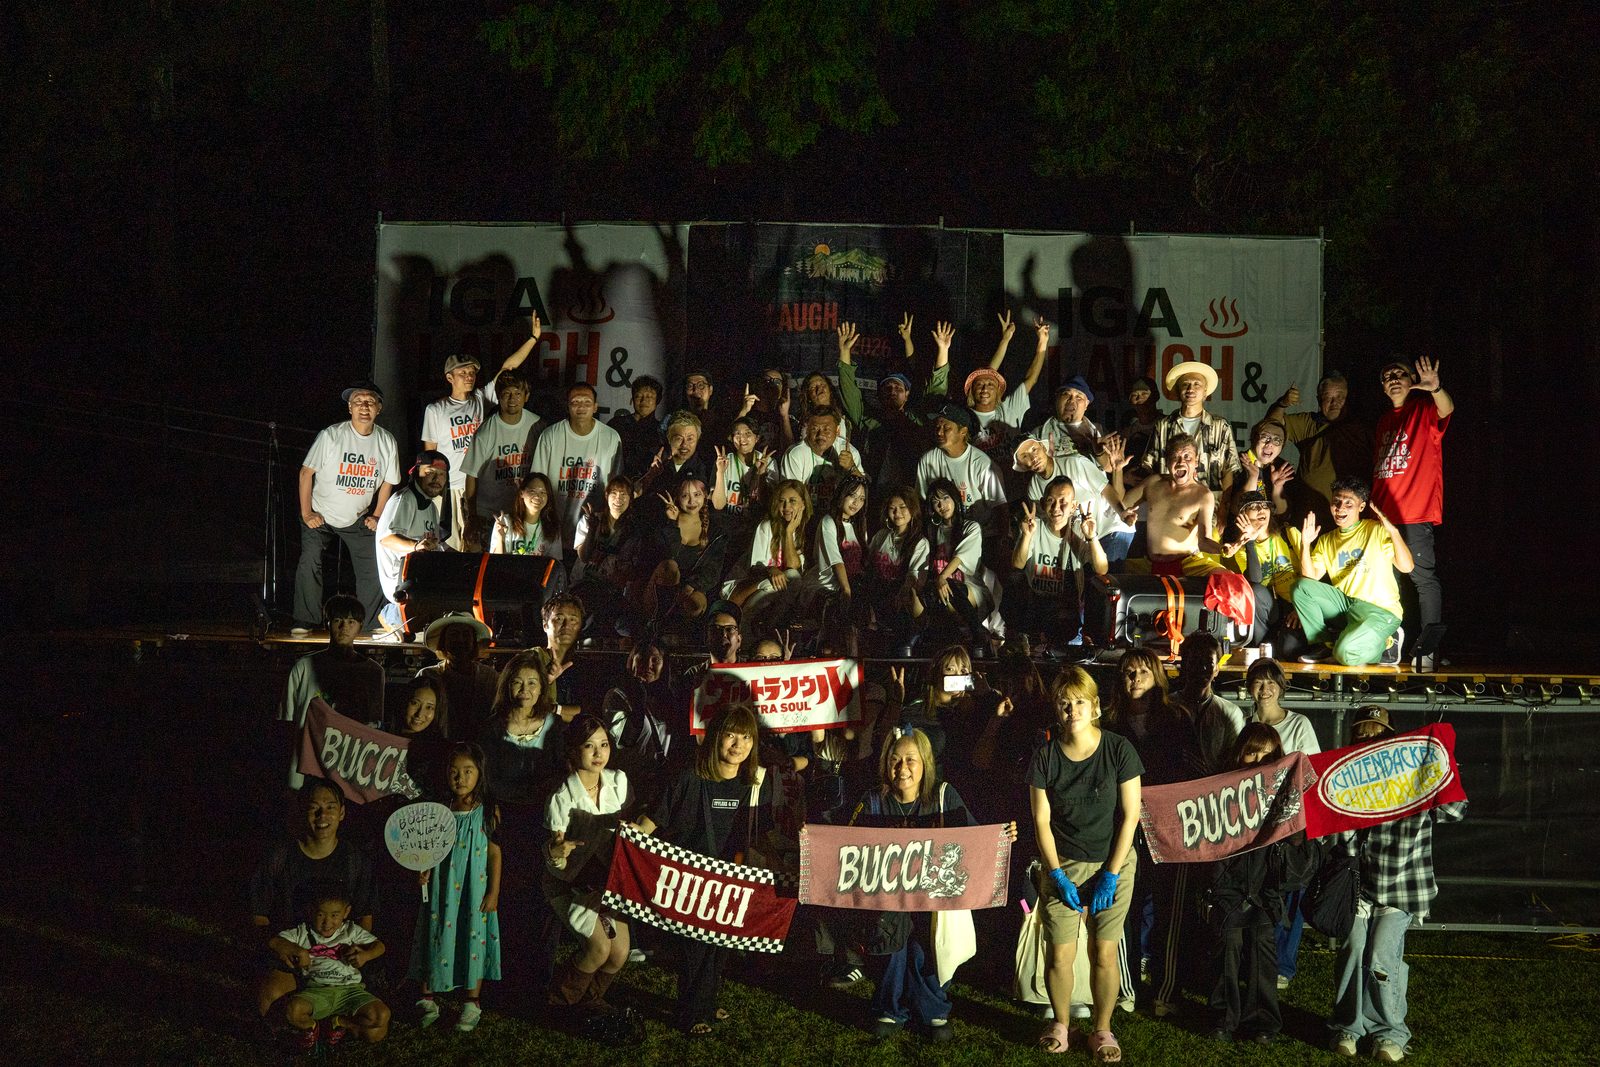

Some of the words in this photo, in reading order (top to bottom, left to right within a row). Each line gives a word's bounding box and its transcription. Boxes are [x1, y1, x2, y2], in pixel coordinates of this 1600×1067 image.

[429, 276, 551, 327] IGA
[777, 301, 840, 332] AUGH
[1057, 286, 1184, 338] IGA
[605, 346, 633, 388] &
[1241, 362, 1268, 404] &
[450, 415, 472, 427] IGA
[452, 436, 473, 451] MUS
[498, 443, 519, 456] IGA
[343, 452, 366, 464] IGA
[496, 453, 528, 468] LAUGH
[562, 456, 584, 467] IGA
[339, 463, 374, 477] LAUGH
[373, 469, 379, 478] &
[559, 466, 593, 479] LAUGH
[335, 475, 366, 488] MUSIC
[558, 479, 585, 491] MUSIC
[346, 487, 366, 496] 2026
[568, 490, 585, 499] 2026
[1038, 553, 1059, 566] IGA
[753, 703, 778, 715] TRA
[780, 701, 812, 713] SOUL
[320, 726, 408, 791] BUCCI
[1176, 772, 1268, 848] BUCCI
[837, 839, 932, 893] BUCCI
[649, 863, 755, 929] BUCCI
